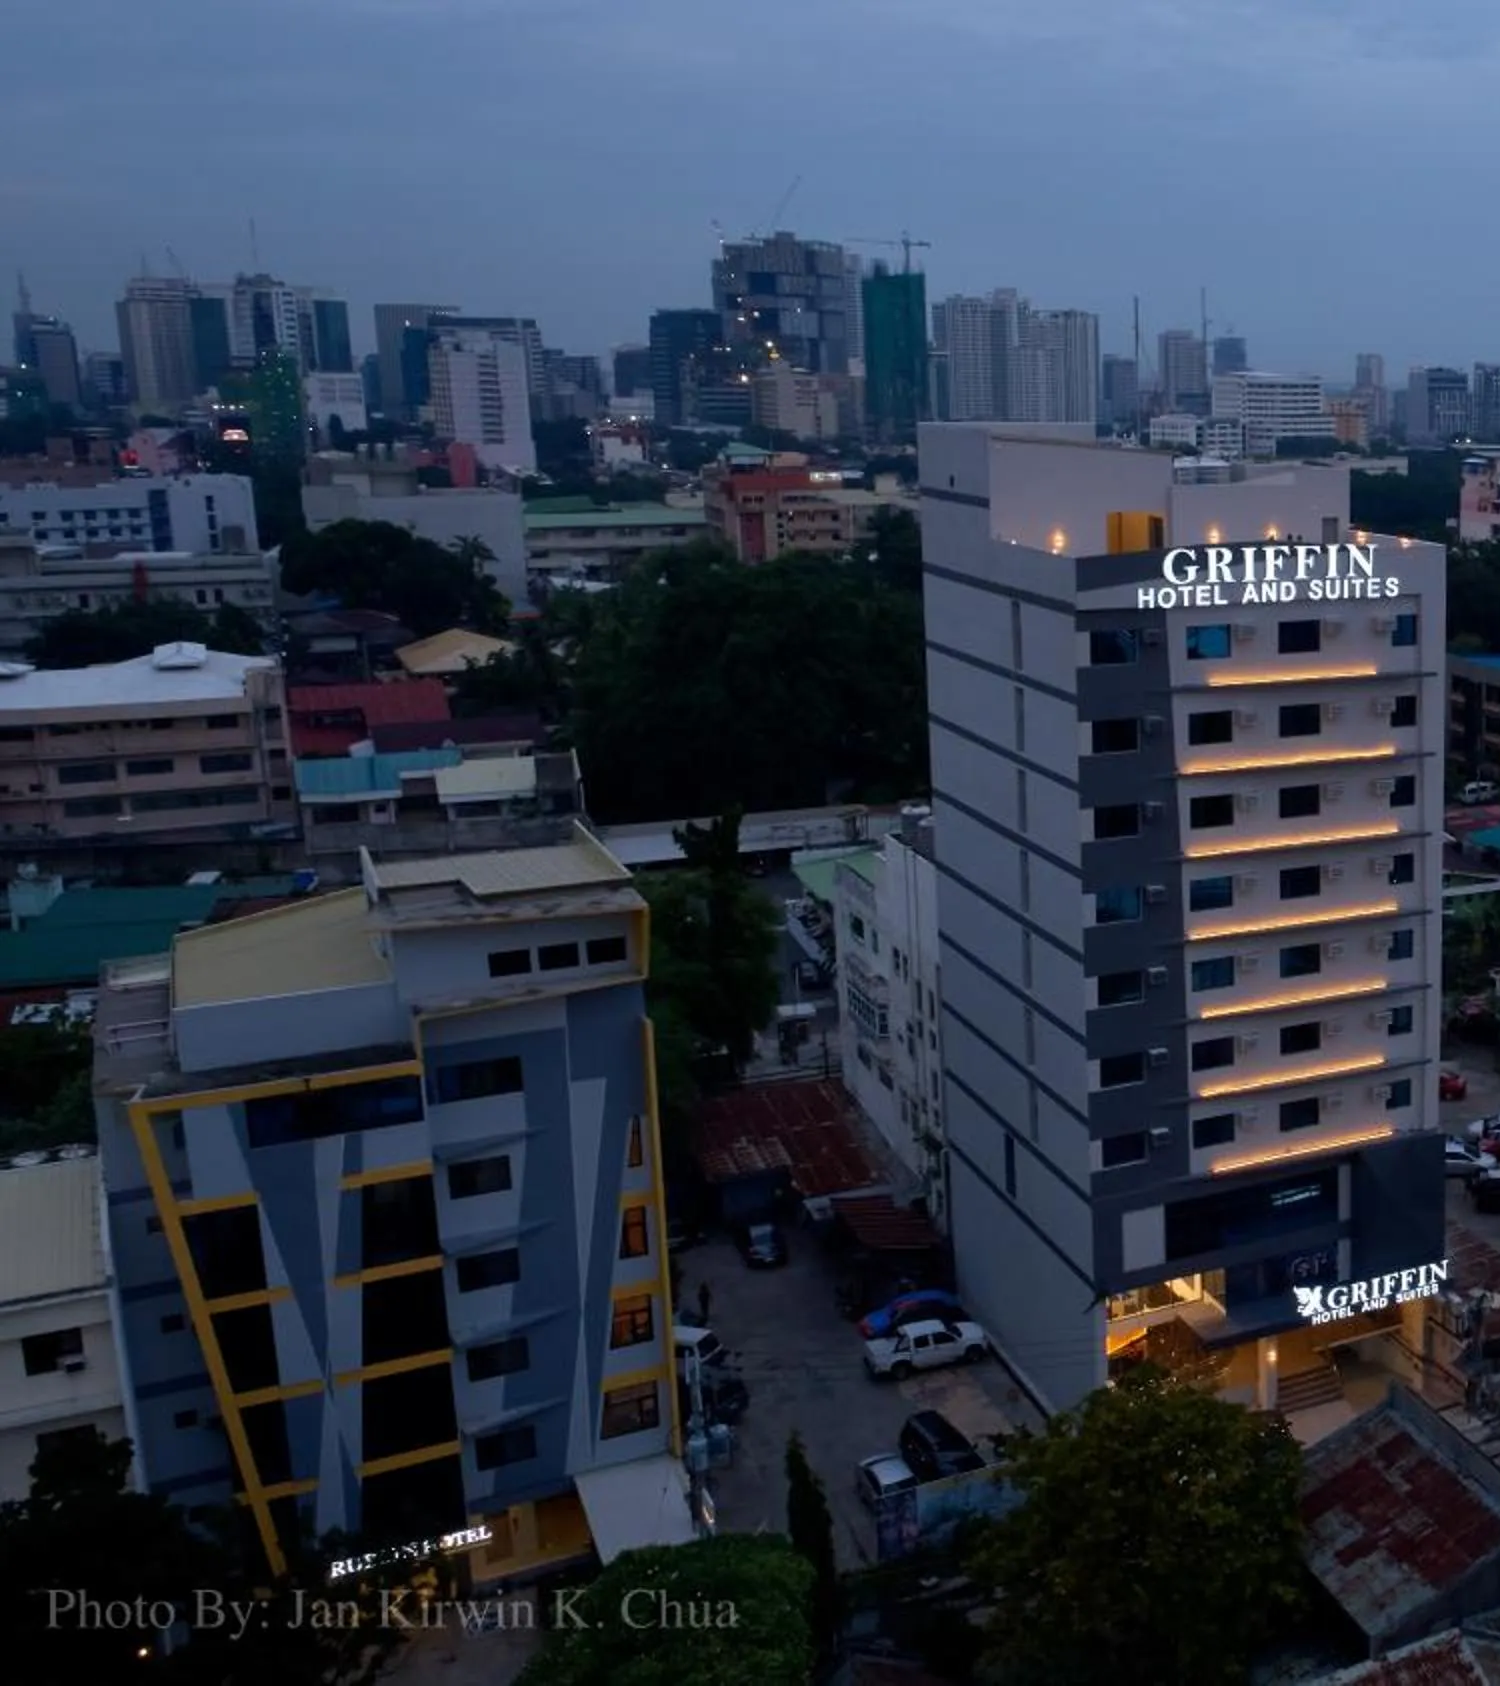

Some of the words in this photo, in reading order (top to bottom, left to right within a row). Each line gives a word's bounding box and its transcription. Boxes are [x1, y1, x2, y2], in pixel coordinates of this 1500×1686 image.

[1162, 543, 1378, 585] GRIFFIN
[1138, 585, 1228, 609] HOTEL
[1242, 578, 1296, 604] AND
[1308, 577, 1399, 600] SUITES
[1311, 1307, 1354, 1326] HOTEL
[1361, 1298, 1388, 1313] AND
[1395, 1284, 1439, 1304] SUITES
[1327, 1259, 1449, 1309] GRIFFIN
